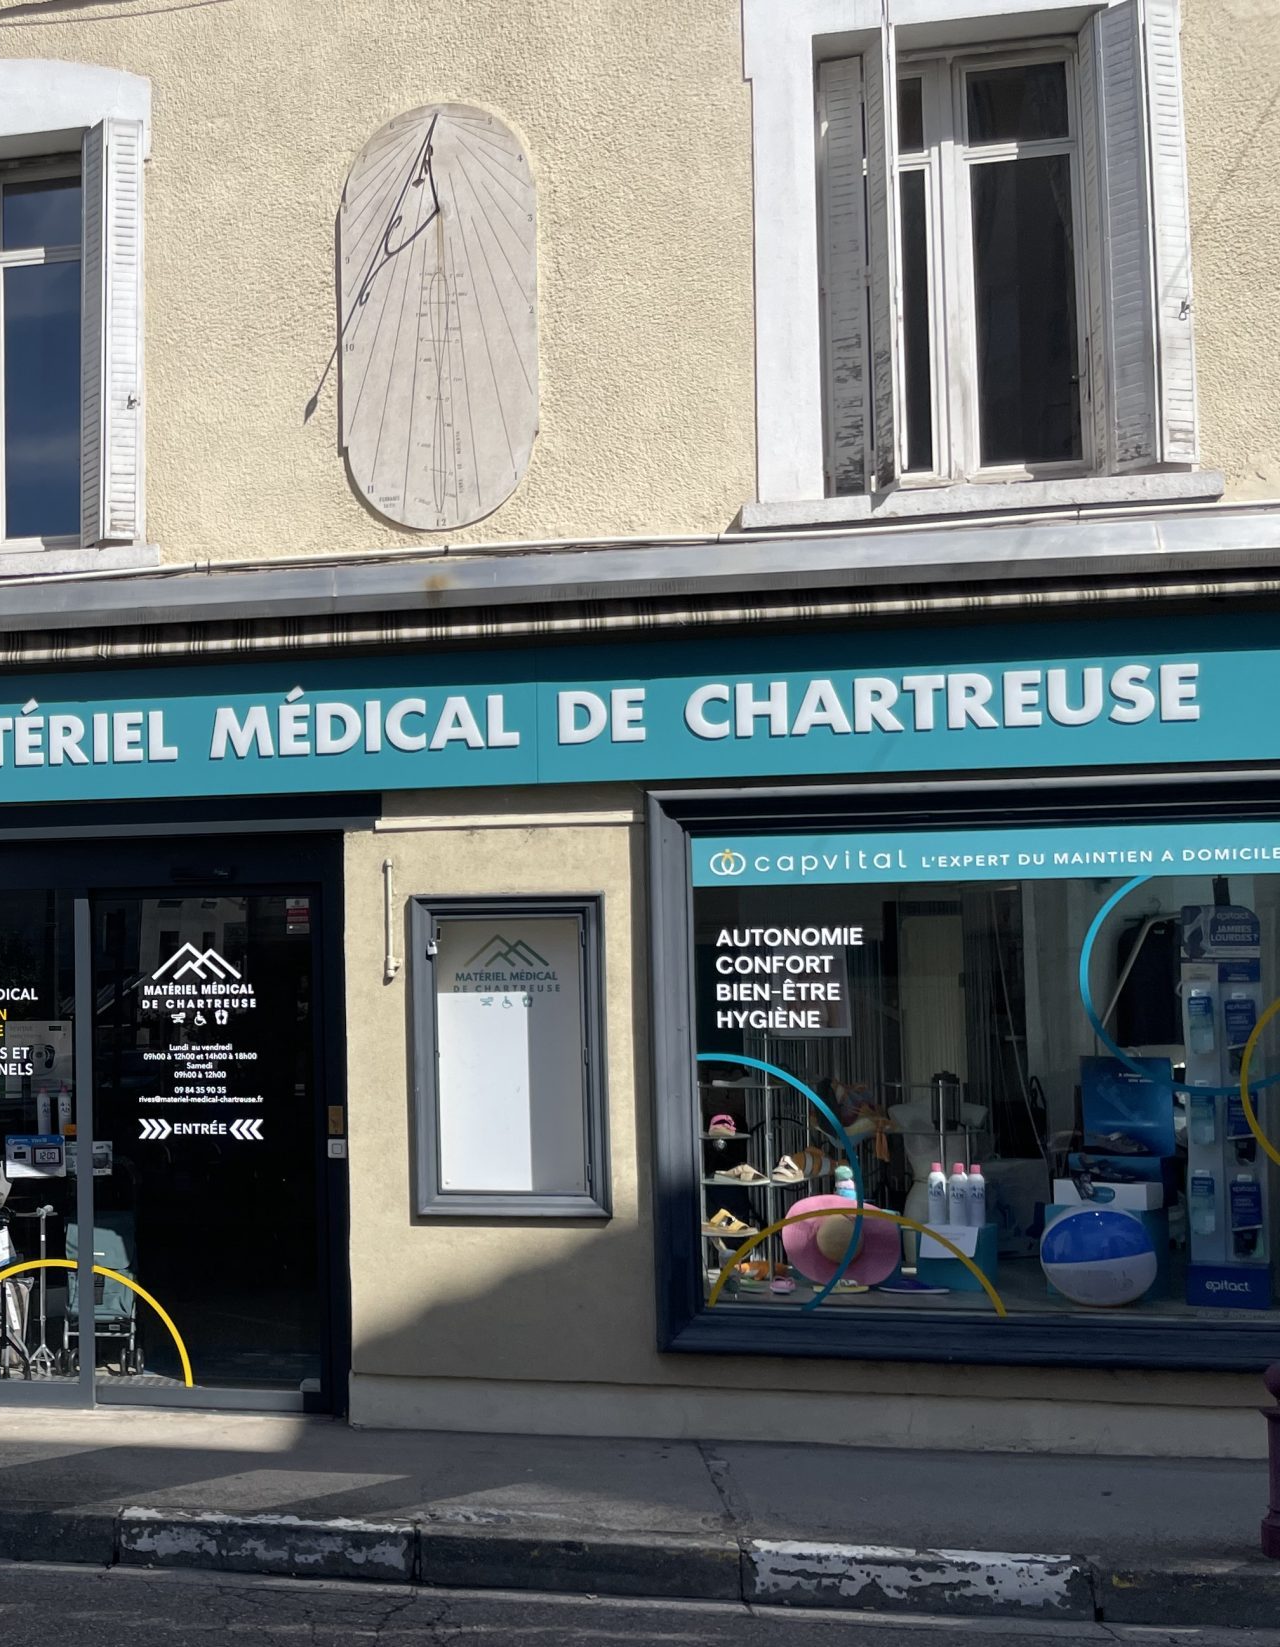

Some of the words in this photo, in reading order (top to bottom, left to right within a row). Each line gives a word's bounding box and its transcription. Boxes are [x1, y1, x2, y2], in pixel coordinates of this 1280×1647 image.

[345, 344, 354, 352] 10
[436, 518, 446, 526] 12
[209, 685, 520, 760] MÉDICAL
[558, 688, 646, 744] DE
[684, 663, 1201, 740] CHARTREUSE
[754, 850, 908, 876] capvital
[921, 854, 1011, 868] L'EXPERT
[1018, 853, 1046, 866] DU
[1053, 850, 1154, 865] MAINTIEN
[1161, 850, 1174, 862] A
[1182, 847, 1280, 862] DOMICILE
[716, 927, 864, 947] AUTONOMIE
[716, 955, 834, 975] CONFORT
[456, 970, 507, 981] MATÉRIEL
[510, 969, 558, 981] MÉDICAL
[144, 982, 198, 996] MATÉRIEL
[201, 982, 254, 995] MÉDICAL
[475, 984, 560, 992] CHARTREUSE
[716, 978, 841, 1001] BIEN-ÊTRE
[142, 1000, 158, 1009] DE
[165, 998, 256, 1008] CHARTREUSE
[716, 1006, 821, 1029] HYGIÈNE
[12, 1047, 30, 1059] ET
[202, 1043, 233, 1051] vendredi
[228, 1052, 233, 1060] à
[234, 1052, 258, 1060] 18h00
[174, 1120, 227, 1135] ENTRÉE
[1205, 1280, 1251, 1293] epitact
